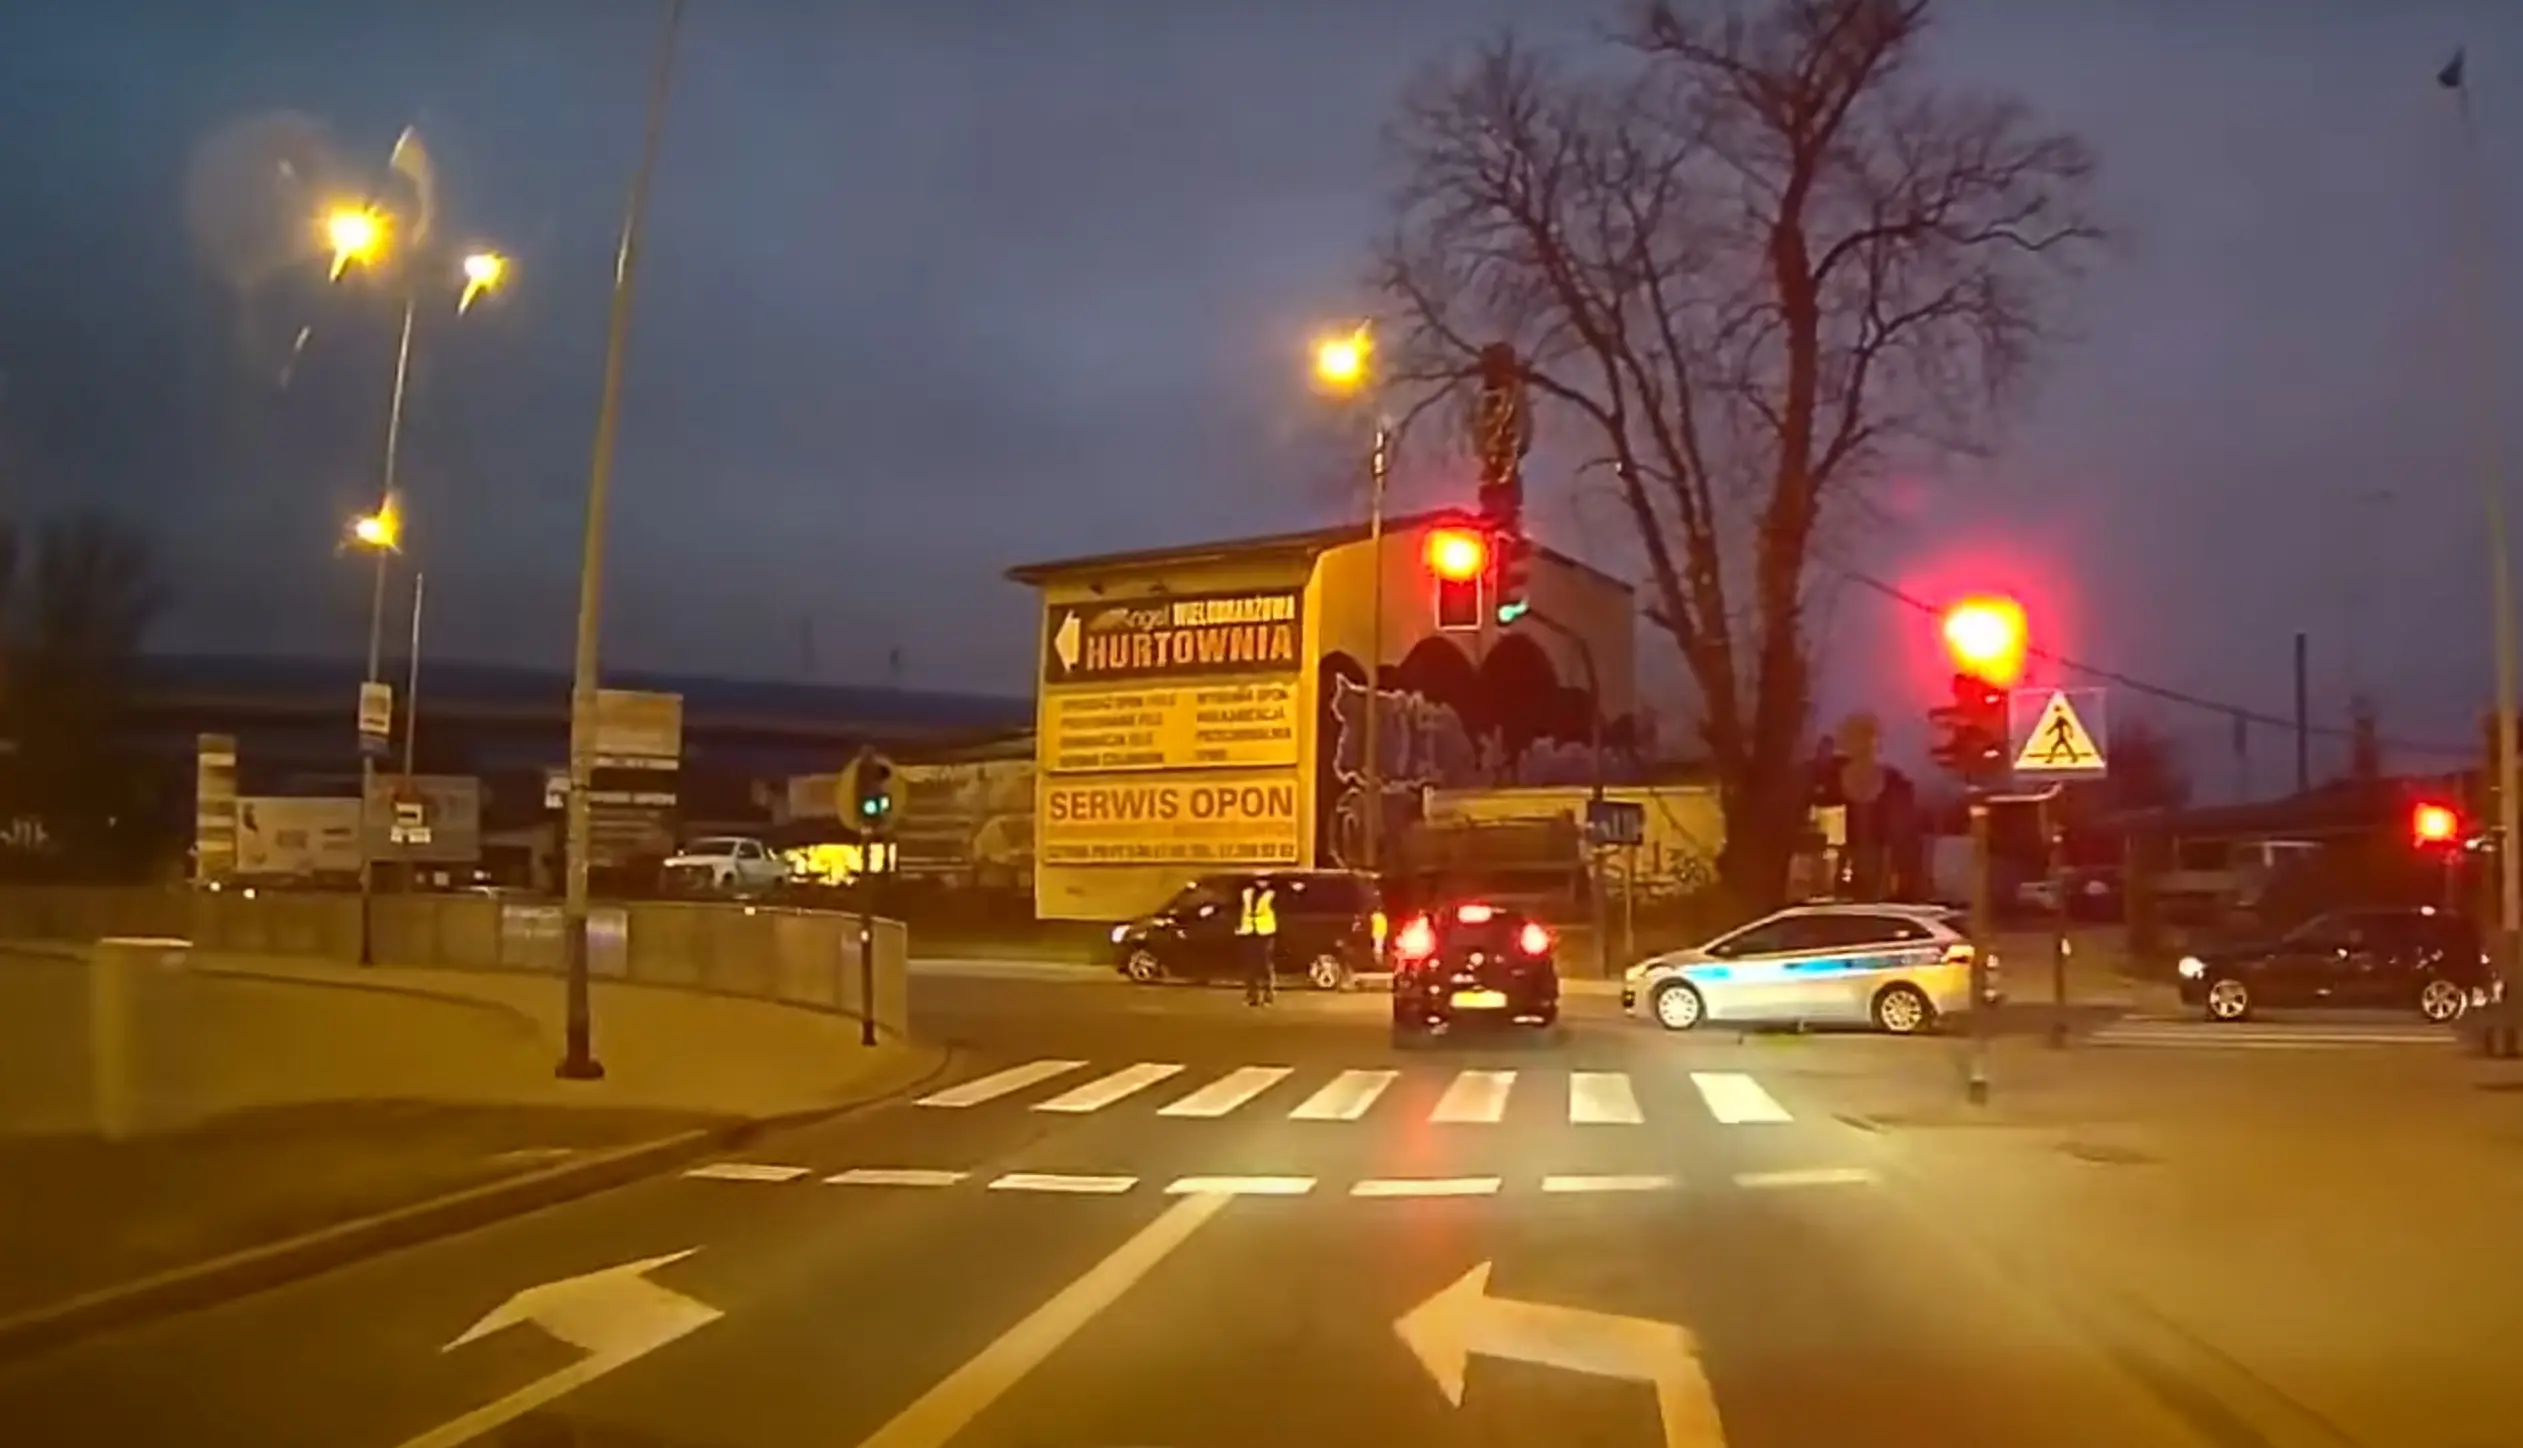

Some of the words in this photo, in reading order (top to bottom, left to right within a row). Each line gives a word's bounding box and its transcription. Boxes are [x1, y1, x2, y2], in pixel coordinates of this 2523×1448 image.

[1086, 624, 1293, 671] HURTOWNIA
[1050, 788, 1180, 820] SERWIS
[1189, 785, 1294, 819] OPON
